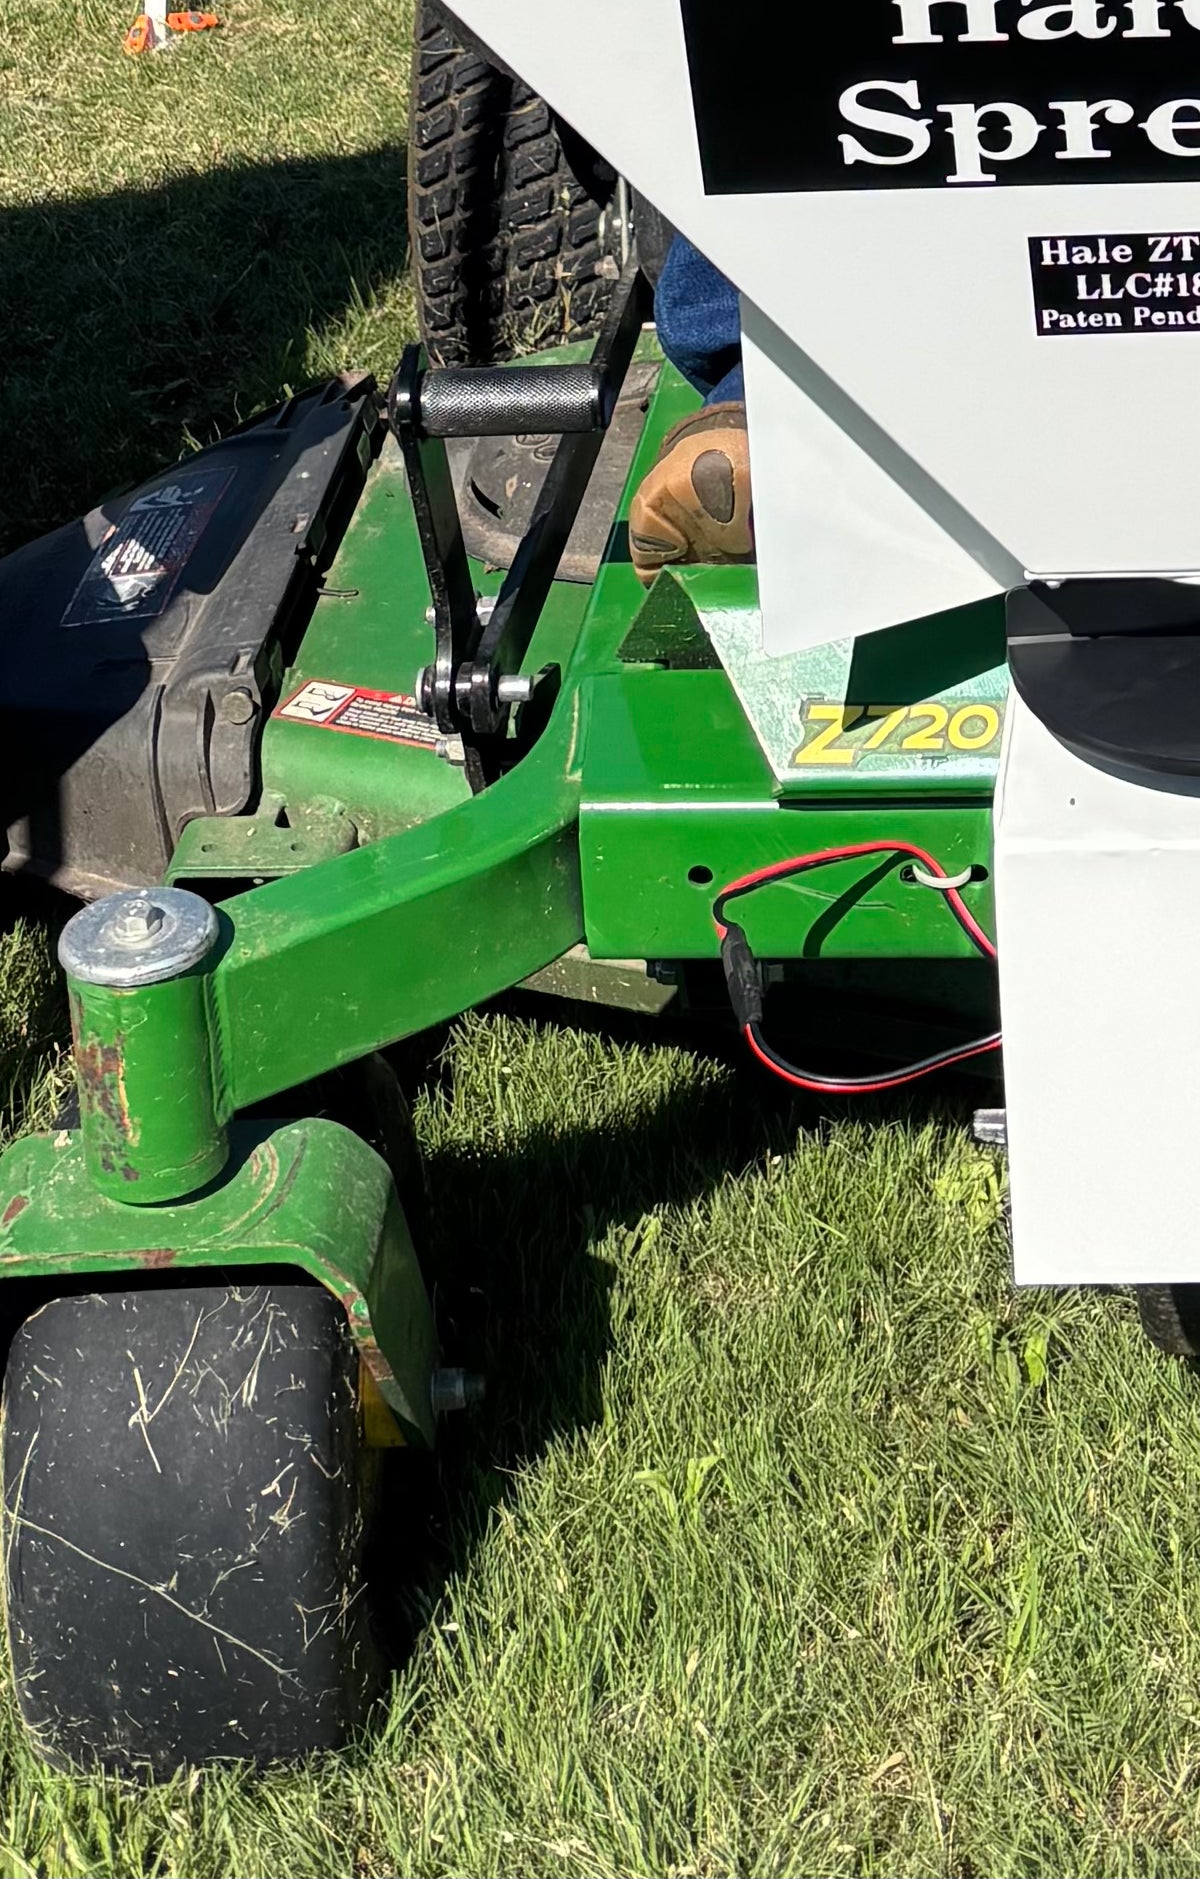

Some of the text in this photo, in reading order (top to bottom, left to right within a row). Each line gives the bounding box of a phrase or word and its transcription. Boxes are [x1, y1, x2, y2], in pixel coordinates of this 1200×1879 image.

[1040, 238, 1133, 266] Hale
[1147, 235, 1200, 262] ZT
[1042, 308, 1123, 329] Paten
[795, 703, 999, 764] Z720
